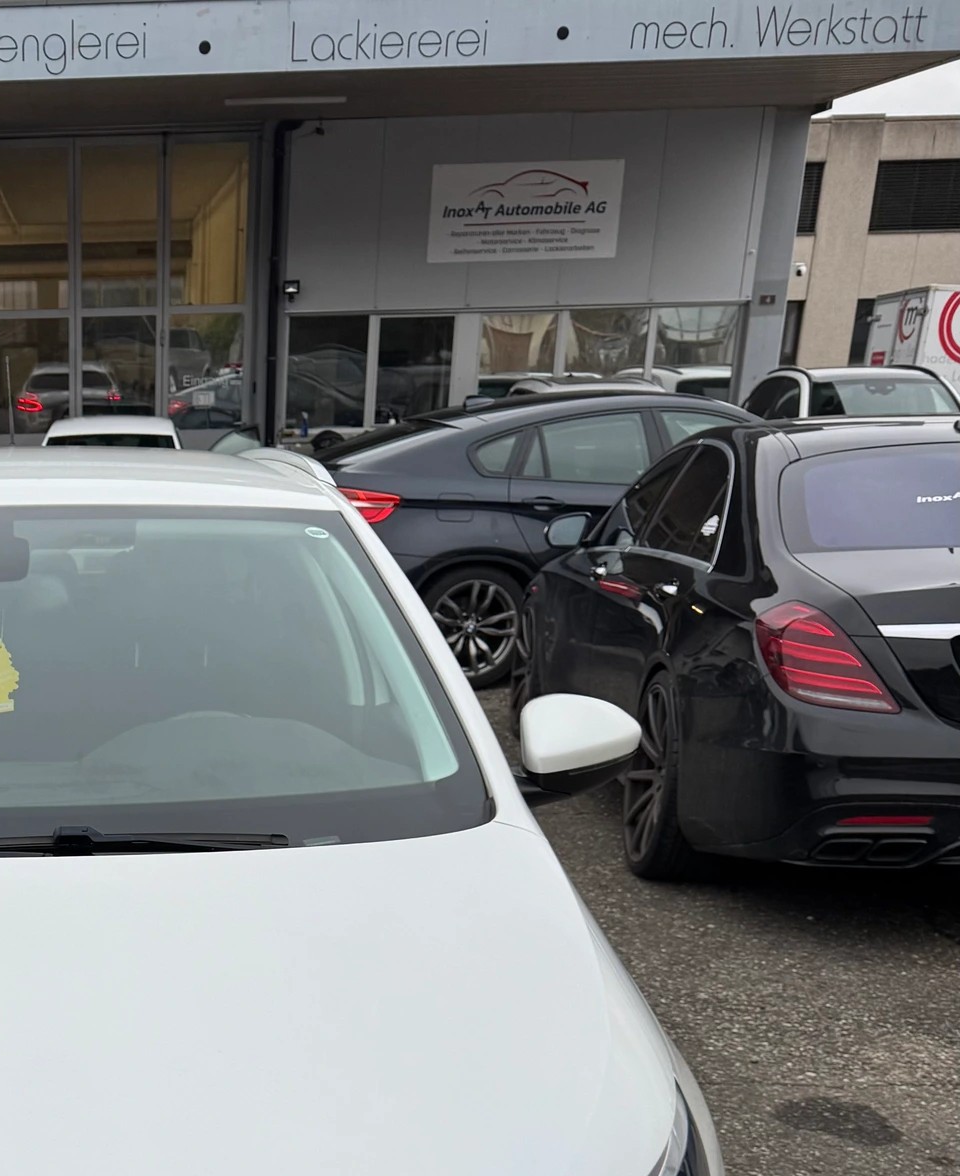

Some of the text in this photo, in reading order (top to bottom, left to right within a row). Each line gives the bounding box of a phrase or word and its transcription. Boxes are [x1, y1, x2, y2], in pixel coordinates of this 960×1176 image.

[291, 18, 489, 62] Lackiererei
[630, 7, 734, 49] mech.
[756, 4, 928, 47] Werkstatt
[495, 202, 581, 217] Automobile
[585, 201, 607, 214] AG
